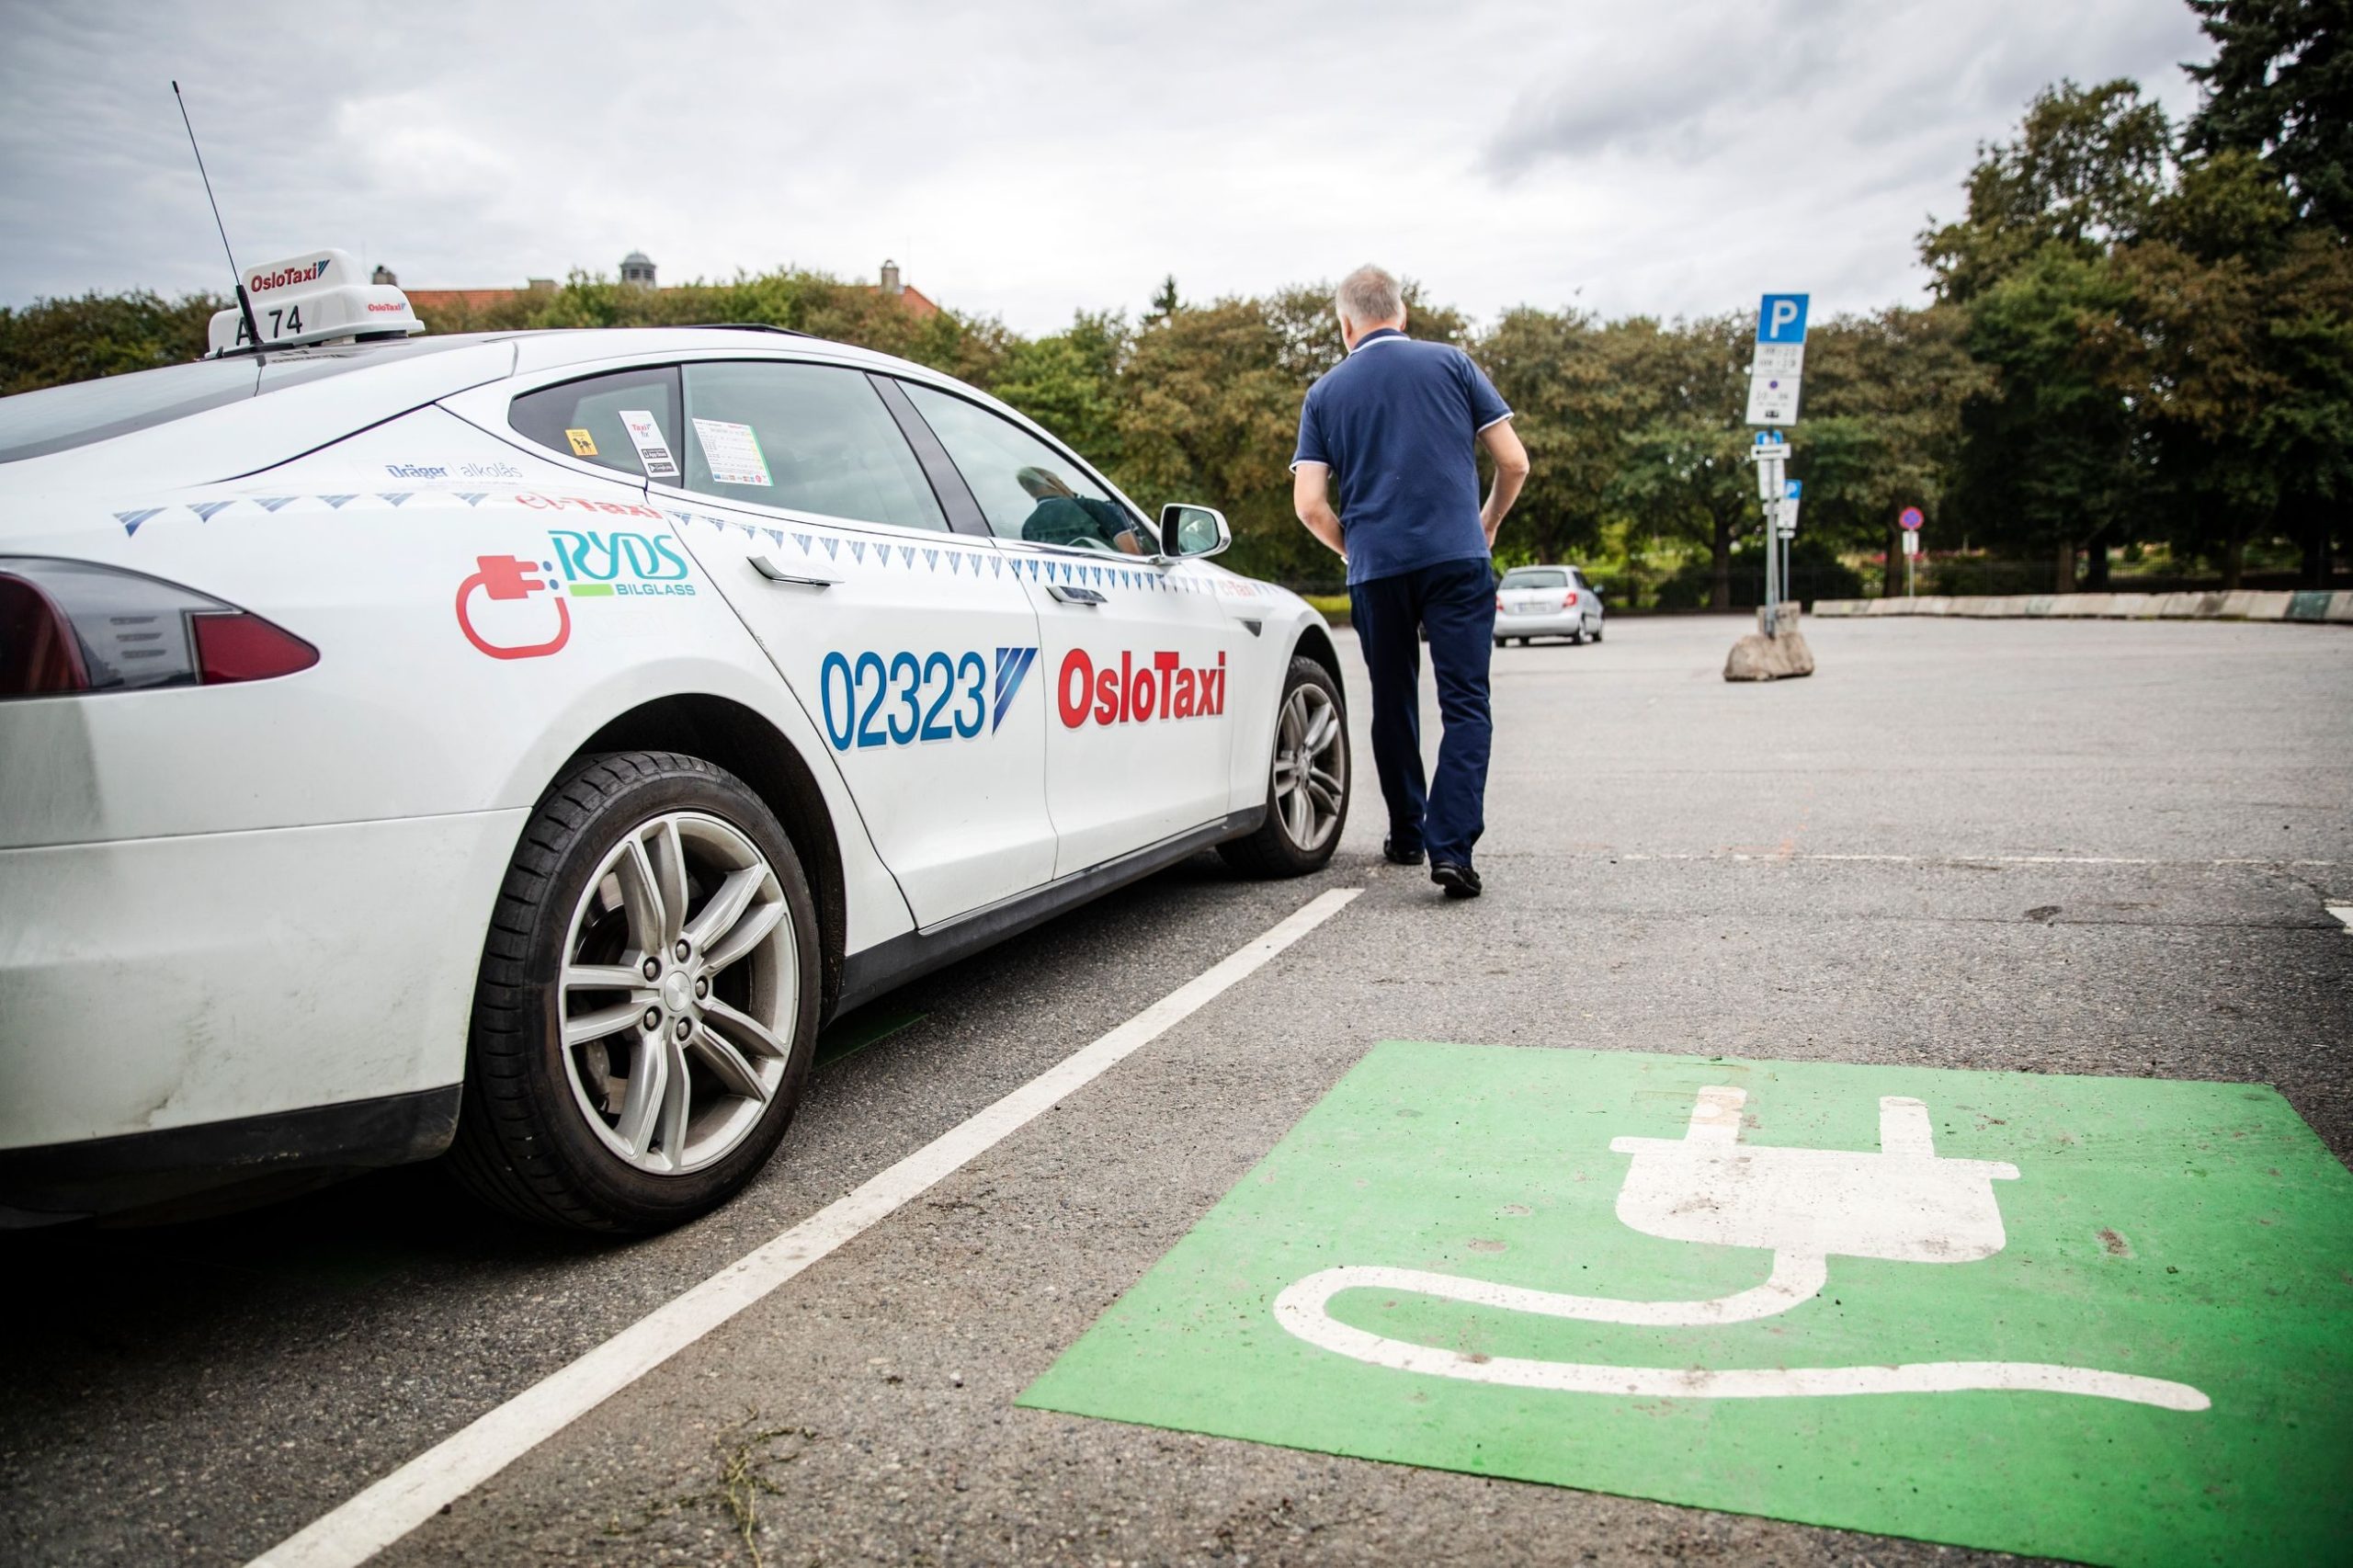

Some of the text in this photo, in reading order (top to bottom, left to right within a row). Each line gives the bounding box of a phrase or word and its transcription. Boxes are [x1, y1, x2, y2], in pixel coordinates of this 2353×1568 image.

[251, 263, 317, 292] OsloTaxi
[268, 305, 302, 338] 74
[368, 302, 402, 312] OsloTaxi
[1769, 300, 1798, 338] P
[385, 462, 523, 479] Dräger alkolås
[548, 530, 688, 581] RYDS
[616, 584, 696, 596] BILGLASS
[821, 648, 1226, 752] 02323 OsloTaxi
